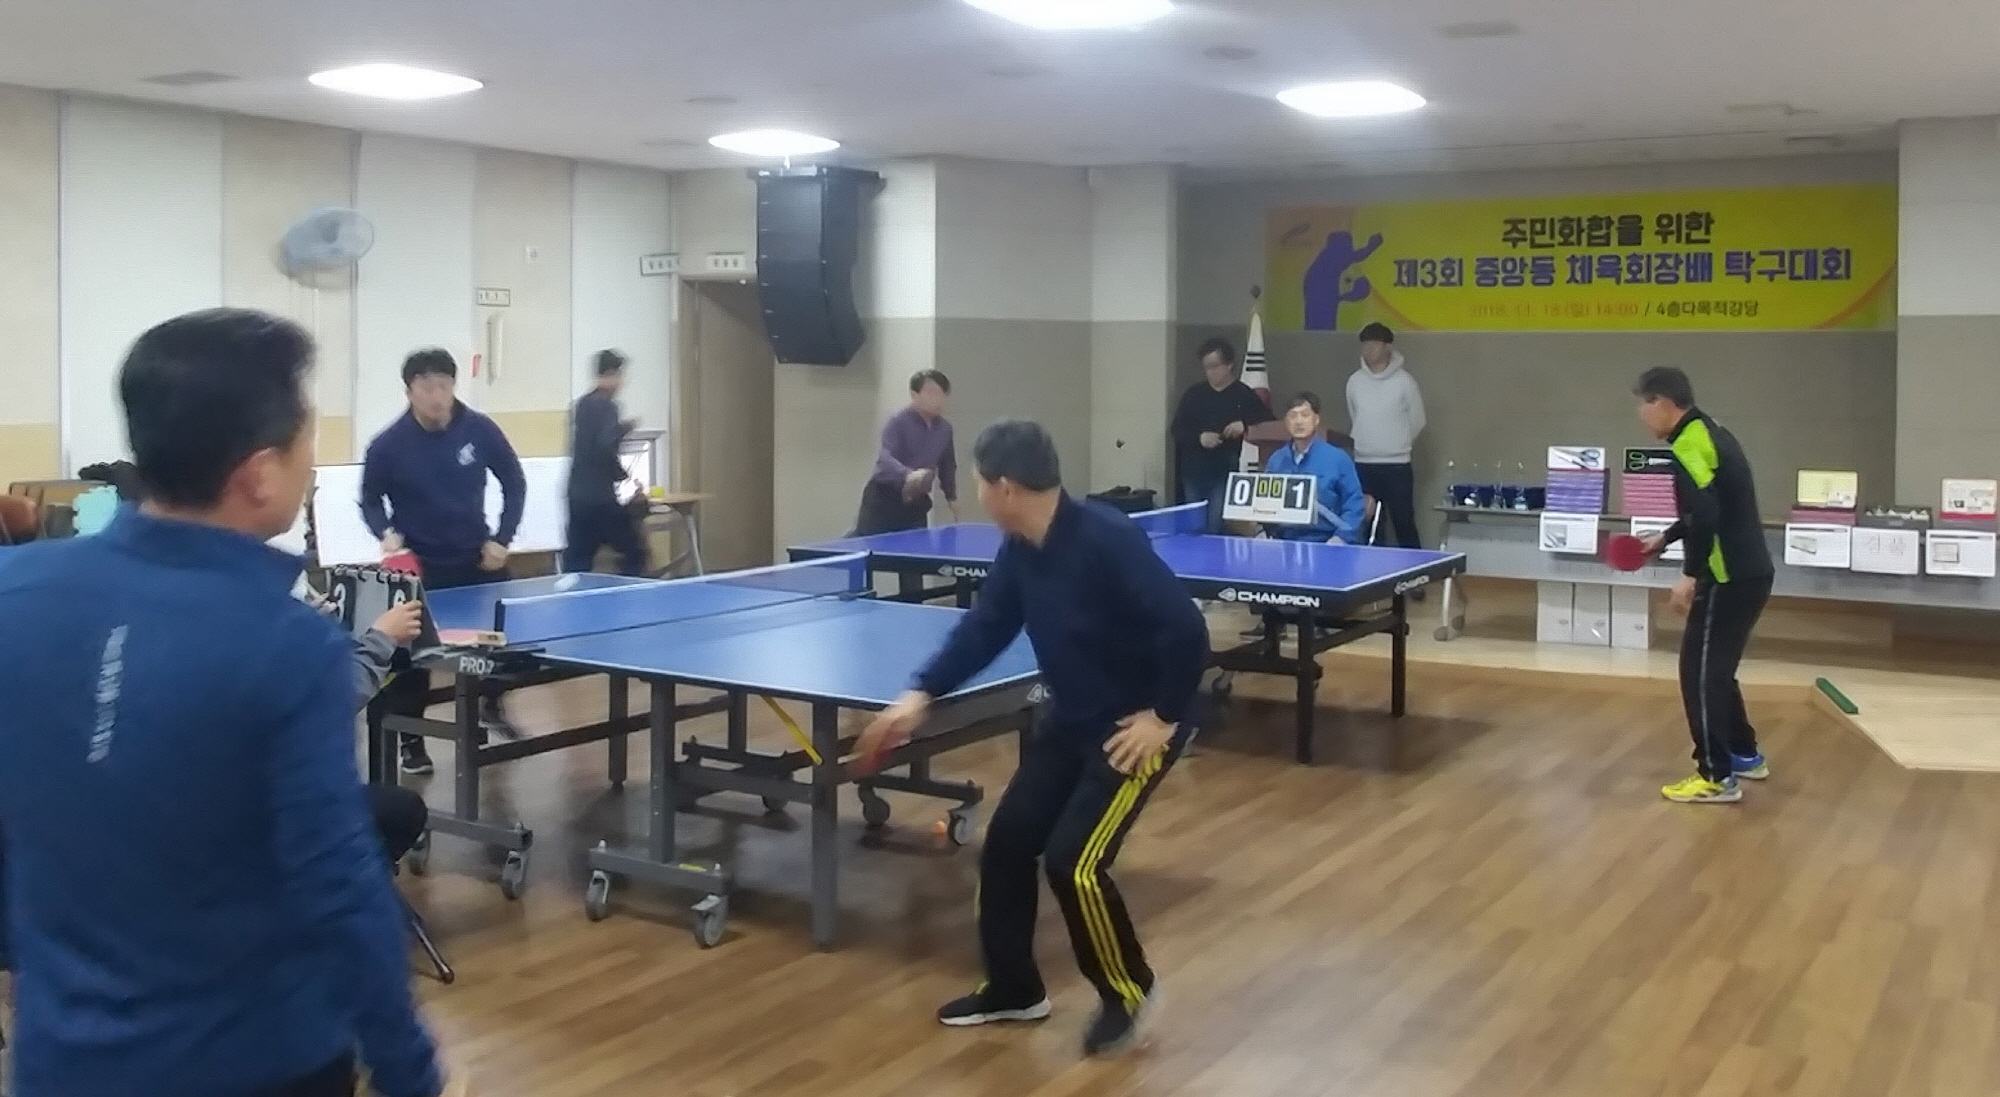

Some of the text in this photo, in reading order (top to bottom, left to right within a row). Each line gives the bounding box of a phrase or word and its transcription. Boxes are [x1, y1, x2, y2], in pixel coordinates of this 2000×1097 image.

[1502, 211, 1715, 248] 주민화합을 위한
[1393, 247, 1852, 288] 제3회 중앙동 체육회장배 탁구대회
[1234, 479, 1252, 505] 0
[1292, 481, 1305, 509] 1
[1238, 591, 1320, 608] CHAMPION
